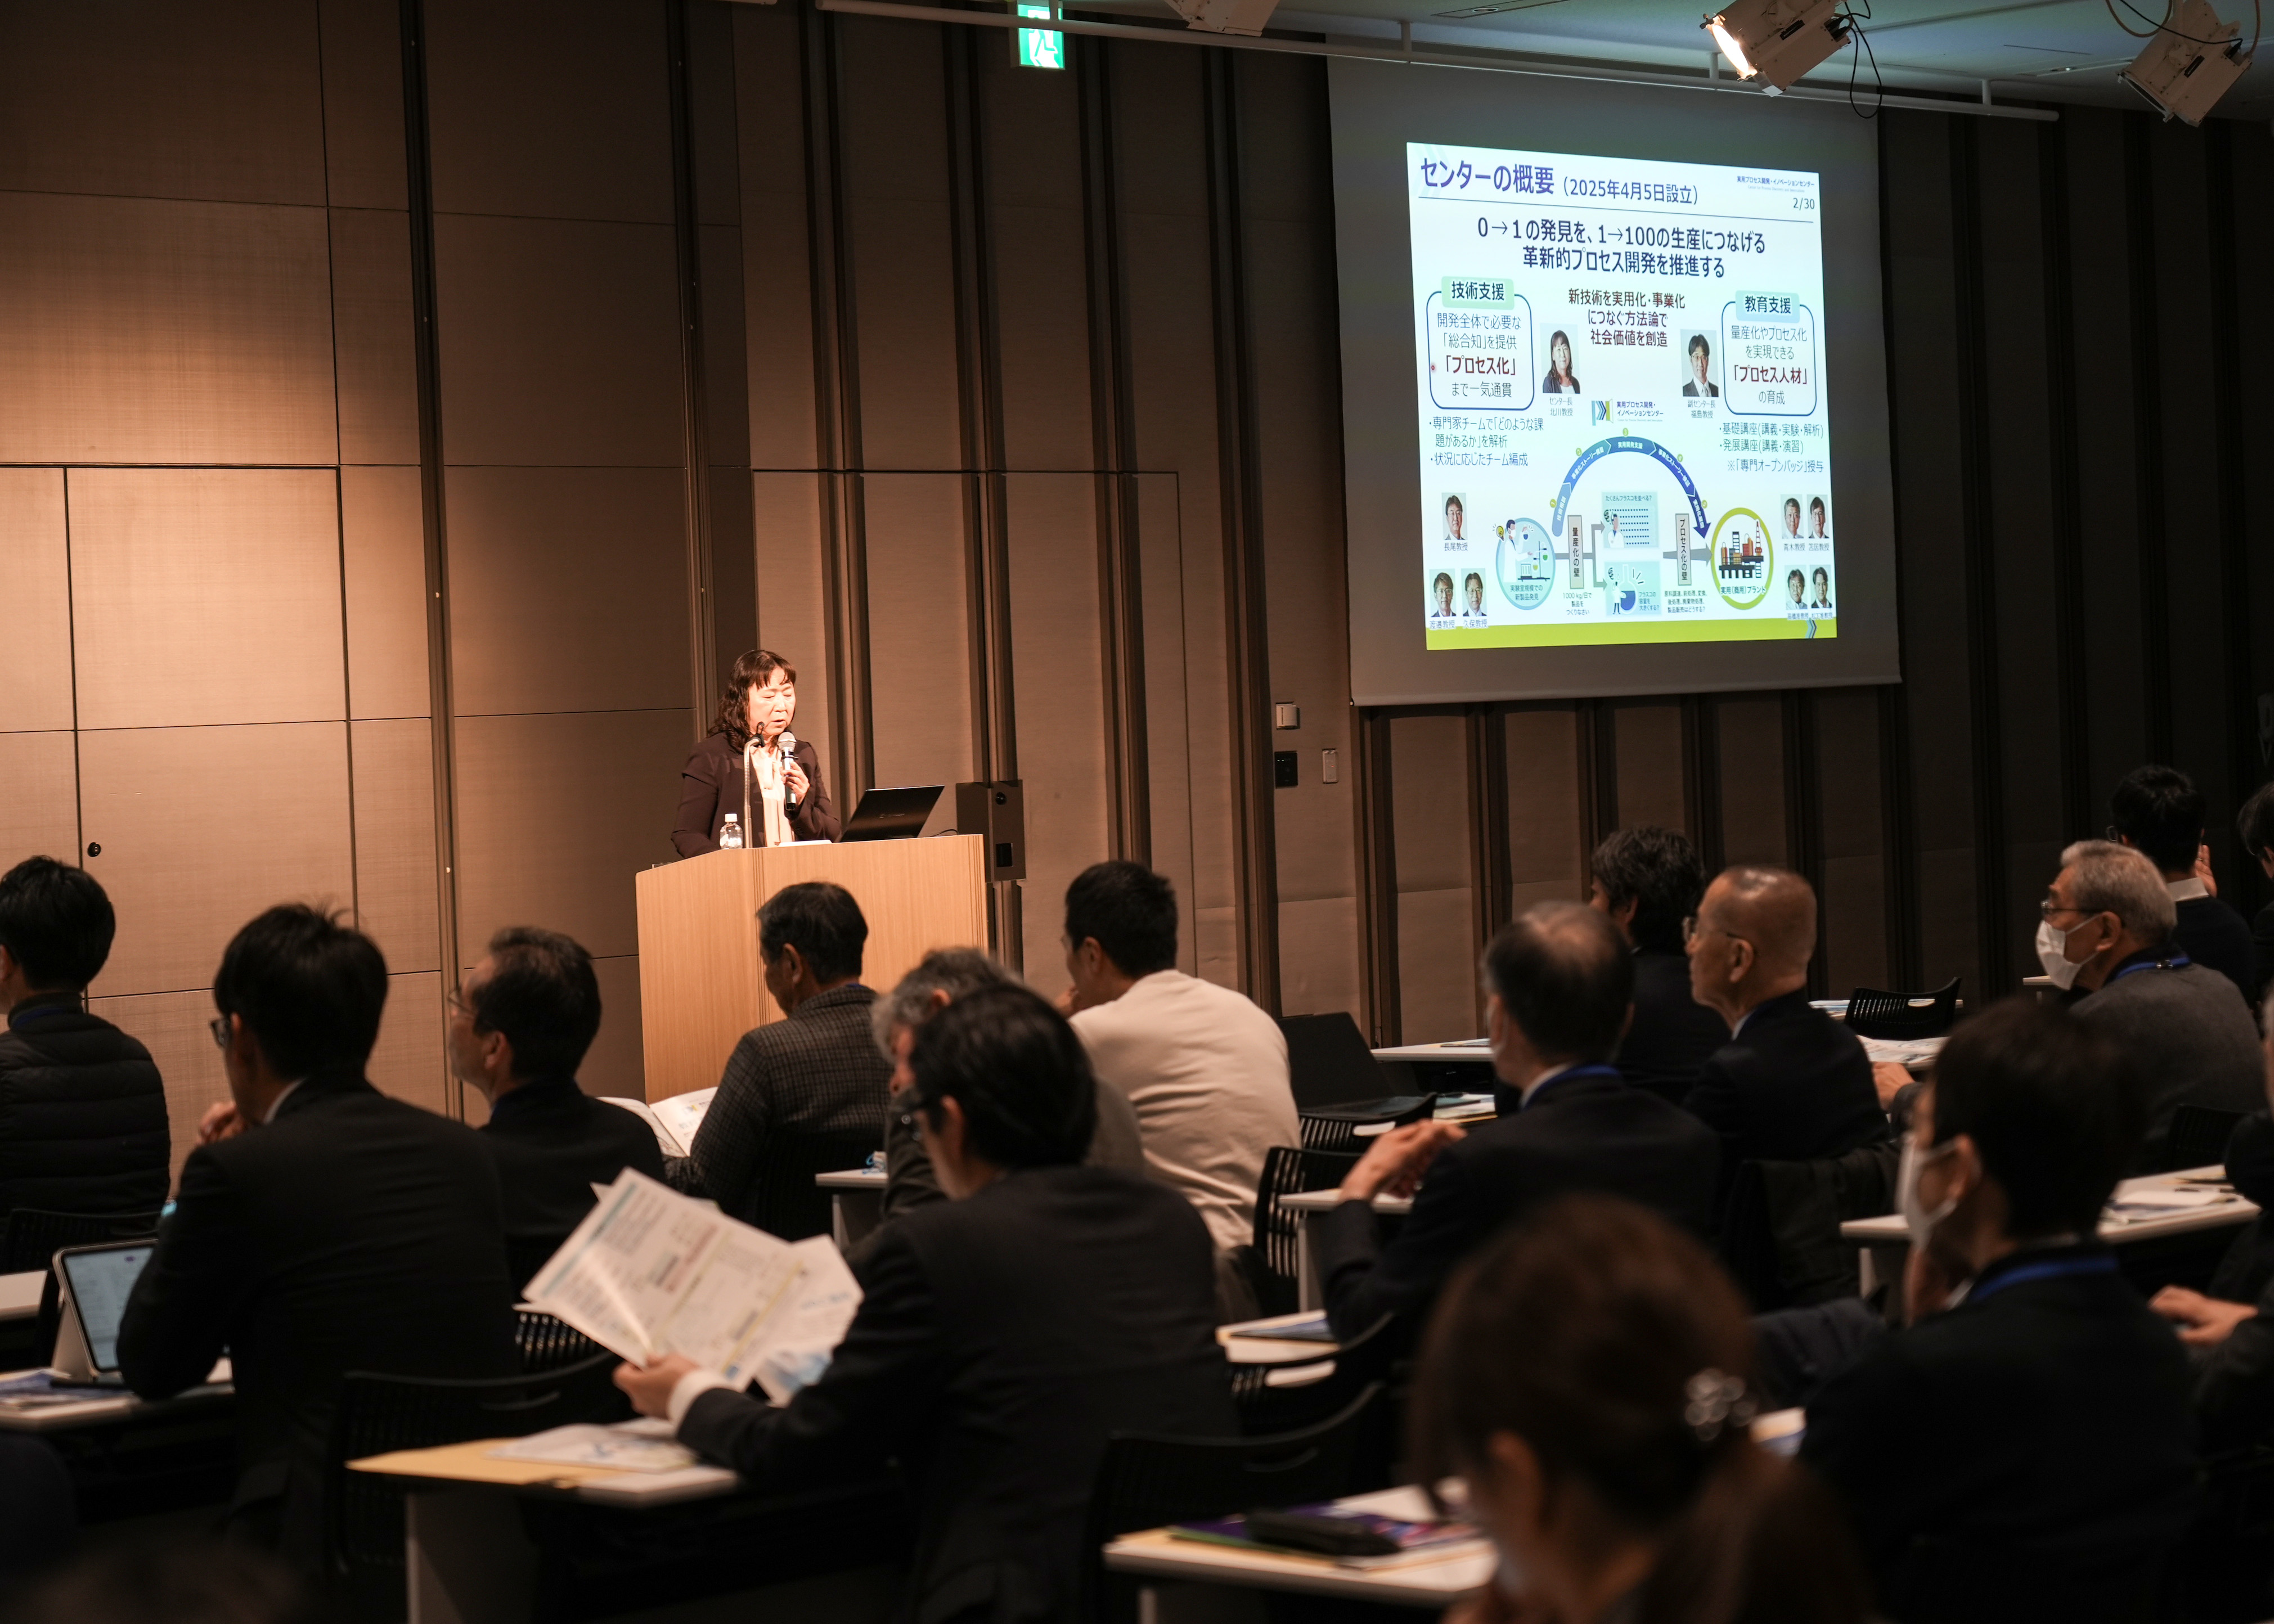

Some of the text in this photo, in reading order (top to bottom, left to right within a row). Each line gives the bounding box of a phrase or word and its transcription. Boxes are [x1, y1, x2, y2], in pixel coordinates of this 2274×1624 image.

[1421, 158, 1554, 196] センターの概要
[1793, 197, 1815, 210] 2/30
[1523, 246, 1725, 278] 革新的プロセス開発を推進する
[1451, 281, 1505, 302] 技術支援
[1568, 288, 1686, 309] 新技術を実用化・事業化
[1745, 295, 1791, 314] 教育支援
[1437, 312, 1522, 330] 開発全体で必要な
[1588, 310, 1668, 329] につなぐ方法論で
[1444, 333, 1517, 351] 「総合知」を提供
[1590, 329, 1669, 348] 社会価値を創造
[1731, 325, 1807, 343] 量産化やプロセス化
[1745, 344, 1795, 361] を実現できる
[1446, 353, 1516, 376] 「プロセス化」
[1734, 365, 1808, 385] 「プロセス人材」
[1451, 381, 1512, 398] まで一気通貫
[1759, 390, 1785, 405] の育成
[1549, 397, 1573, 406] センター長
[1435, 434, 1508, 448] 題があるか」を解析
[1444, 542, 1468, 551] 長尾教授
[1679, 519, 1688, 581] プロセス化の壁
[1783, 543, 1805, 551] 青木教授
